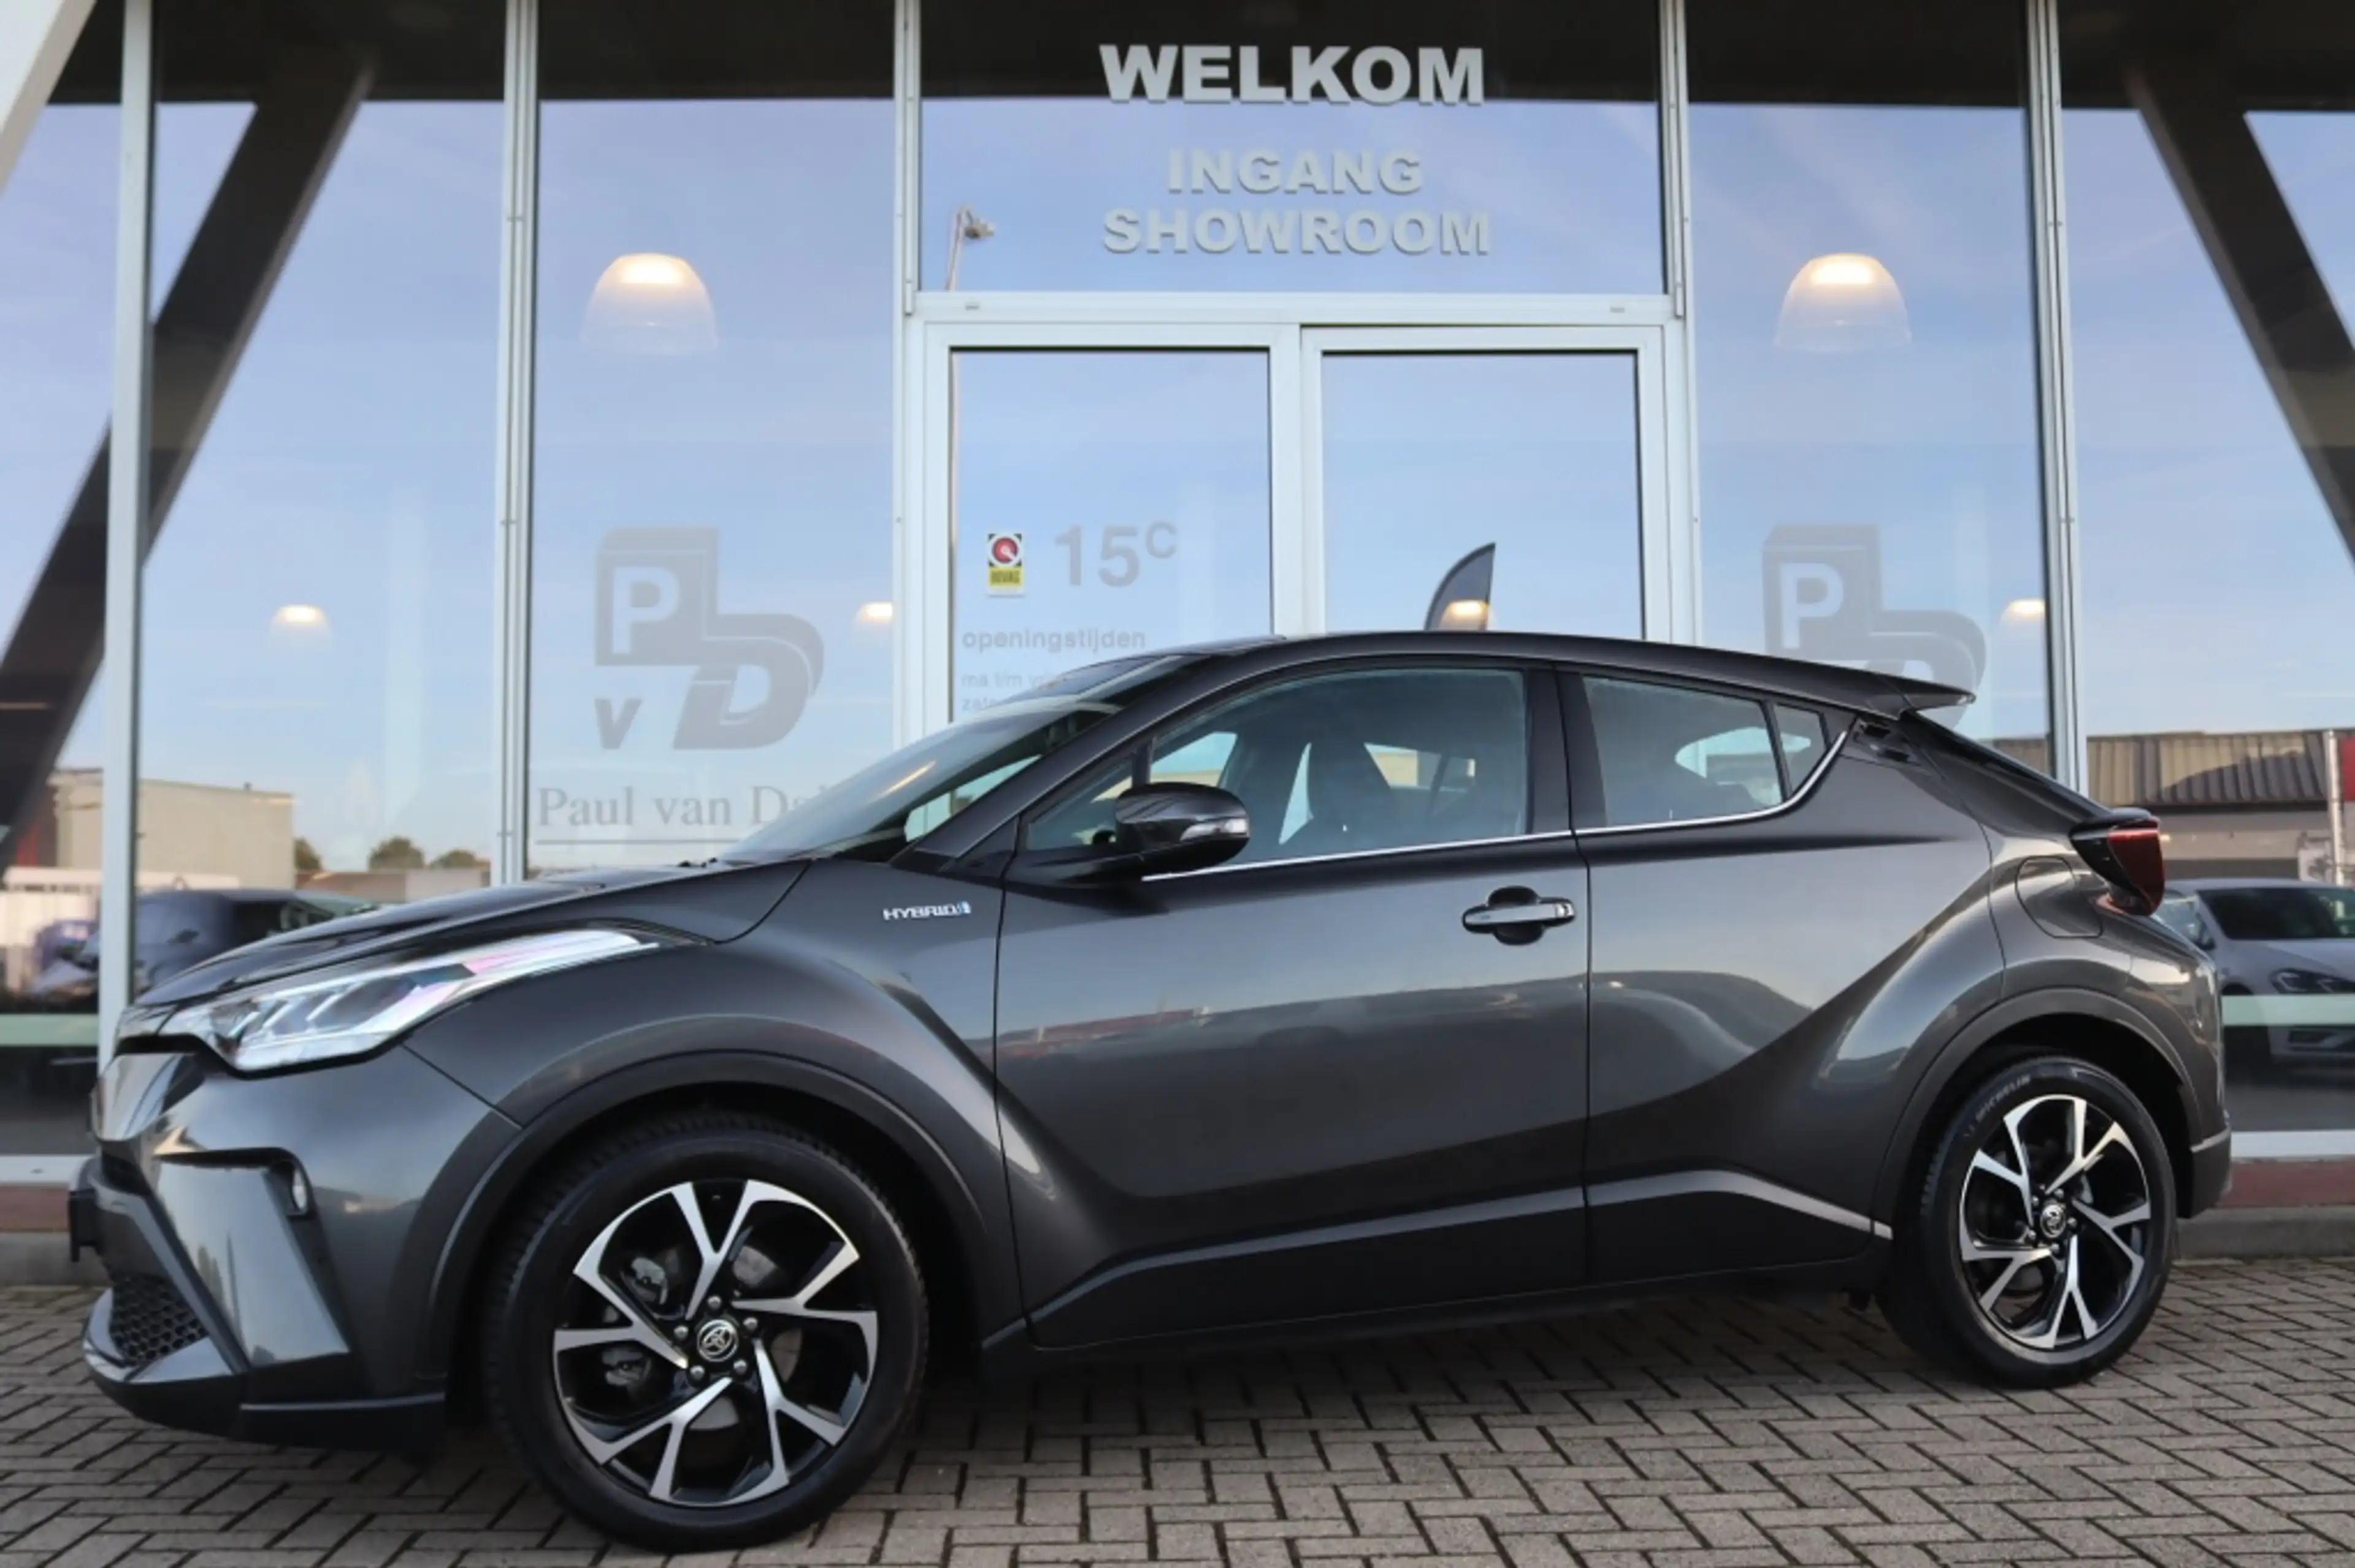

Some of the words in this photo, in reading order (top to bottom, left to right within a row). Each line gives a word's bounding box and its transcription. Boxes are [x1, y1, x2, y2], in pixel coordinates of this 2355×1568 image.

[1099, 45, 1485, 105] WELKOM
[1167, 149, 1423, 195] INGANG
[1103, 208, 1491, 256] SHOWROOM
[962, 627, 1146, 653] openingstijden
[537, 786, 634, 827] Paul
[653, 796, 732, 827] van
[883, 903, 957, 920] HYBRID
